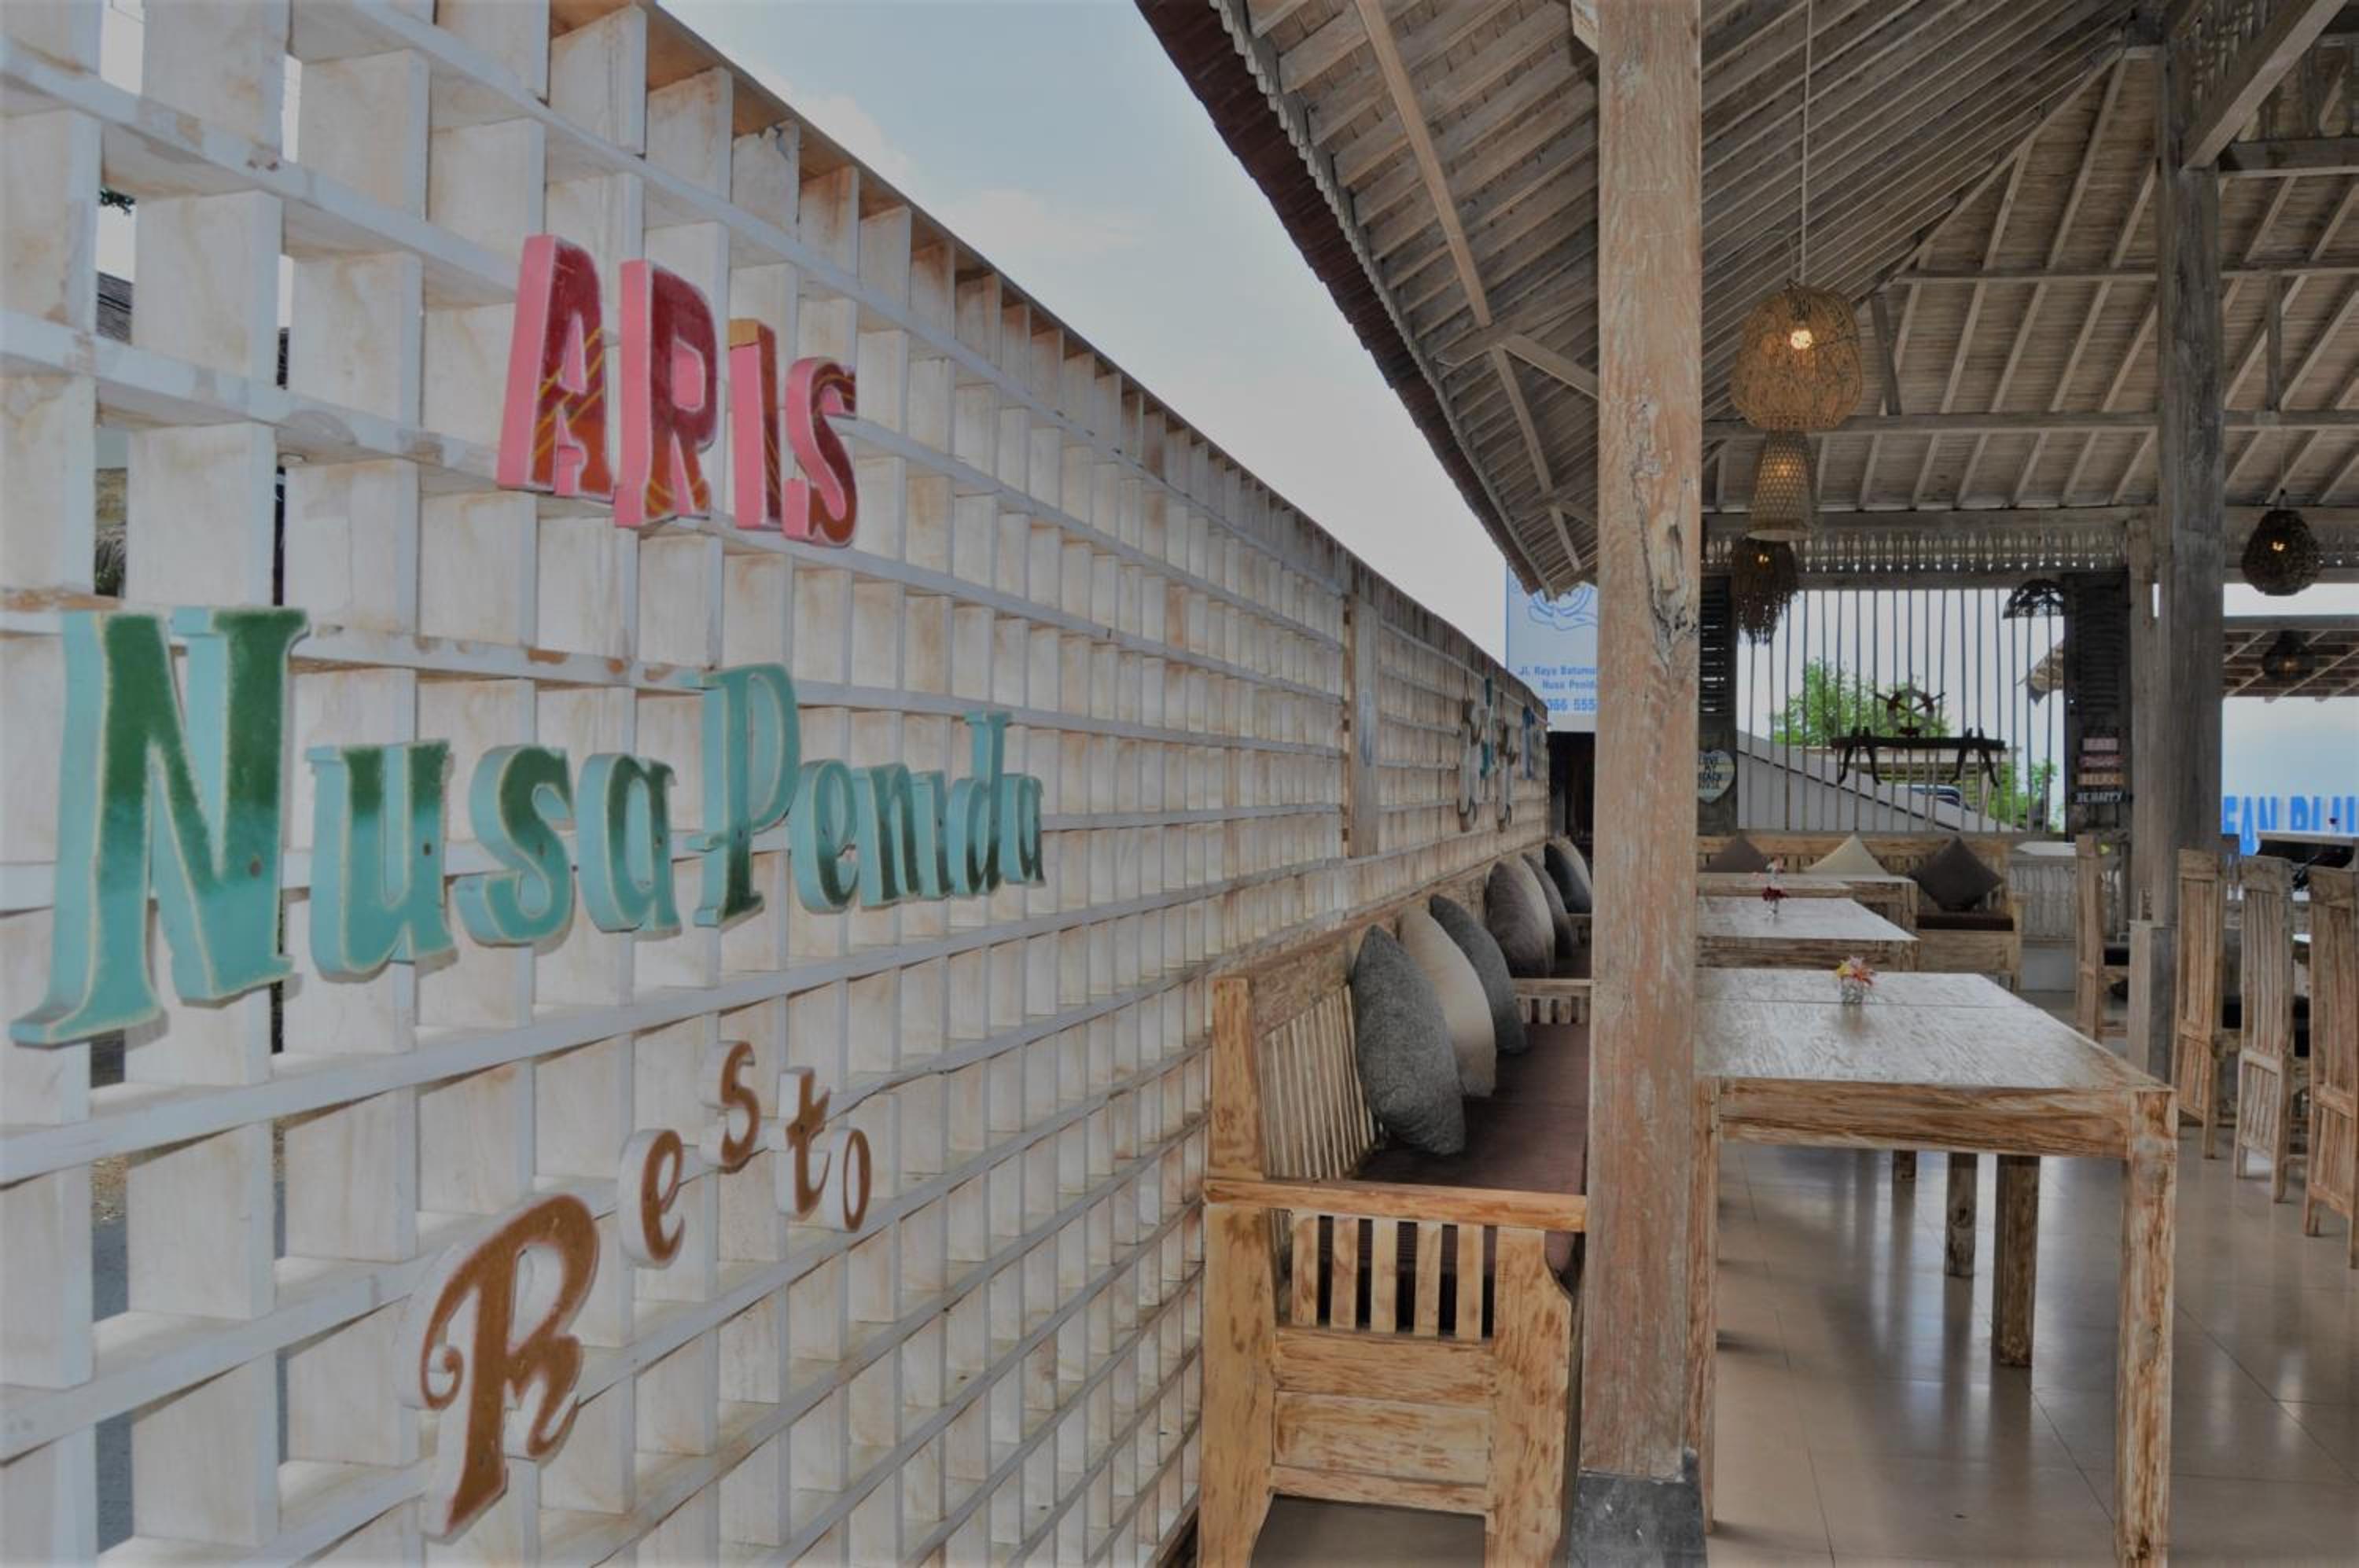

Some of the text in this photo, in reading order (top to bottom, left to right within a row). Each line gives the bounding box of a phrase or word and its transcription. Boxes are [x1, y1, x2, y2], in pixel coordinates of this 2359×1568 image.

[496, 234, 858, 549] ARIS
[9, 605, 684, 1047] Nusa
[1542, 679, 1598, 690] Nusa Penid
[406, 1040, 871, 1540] Resto
